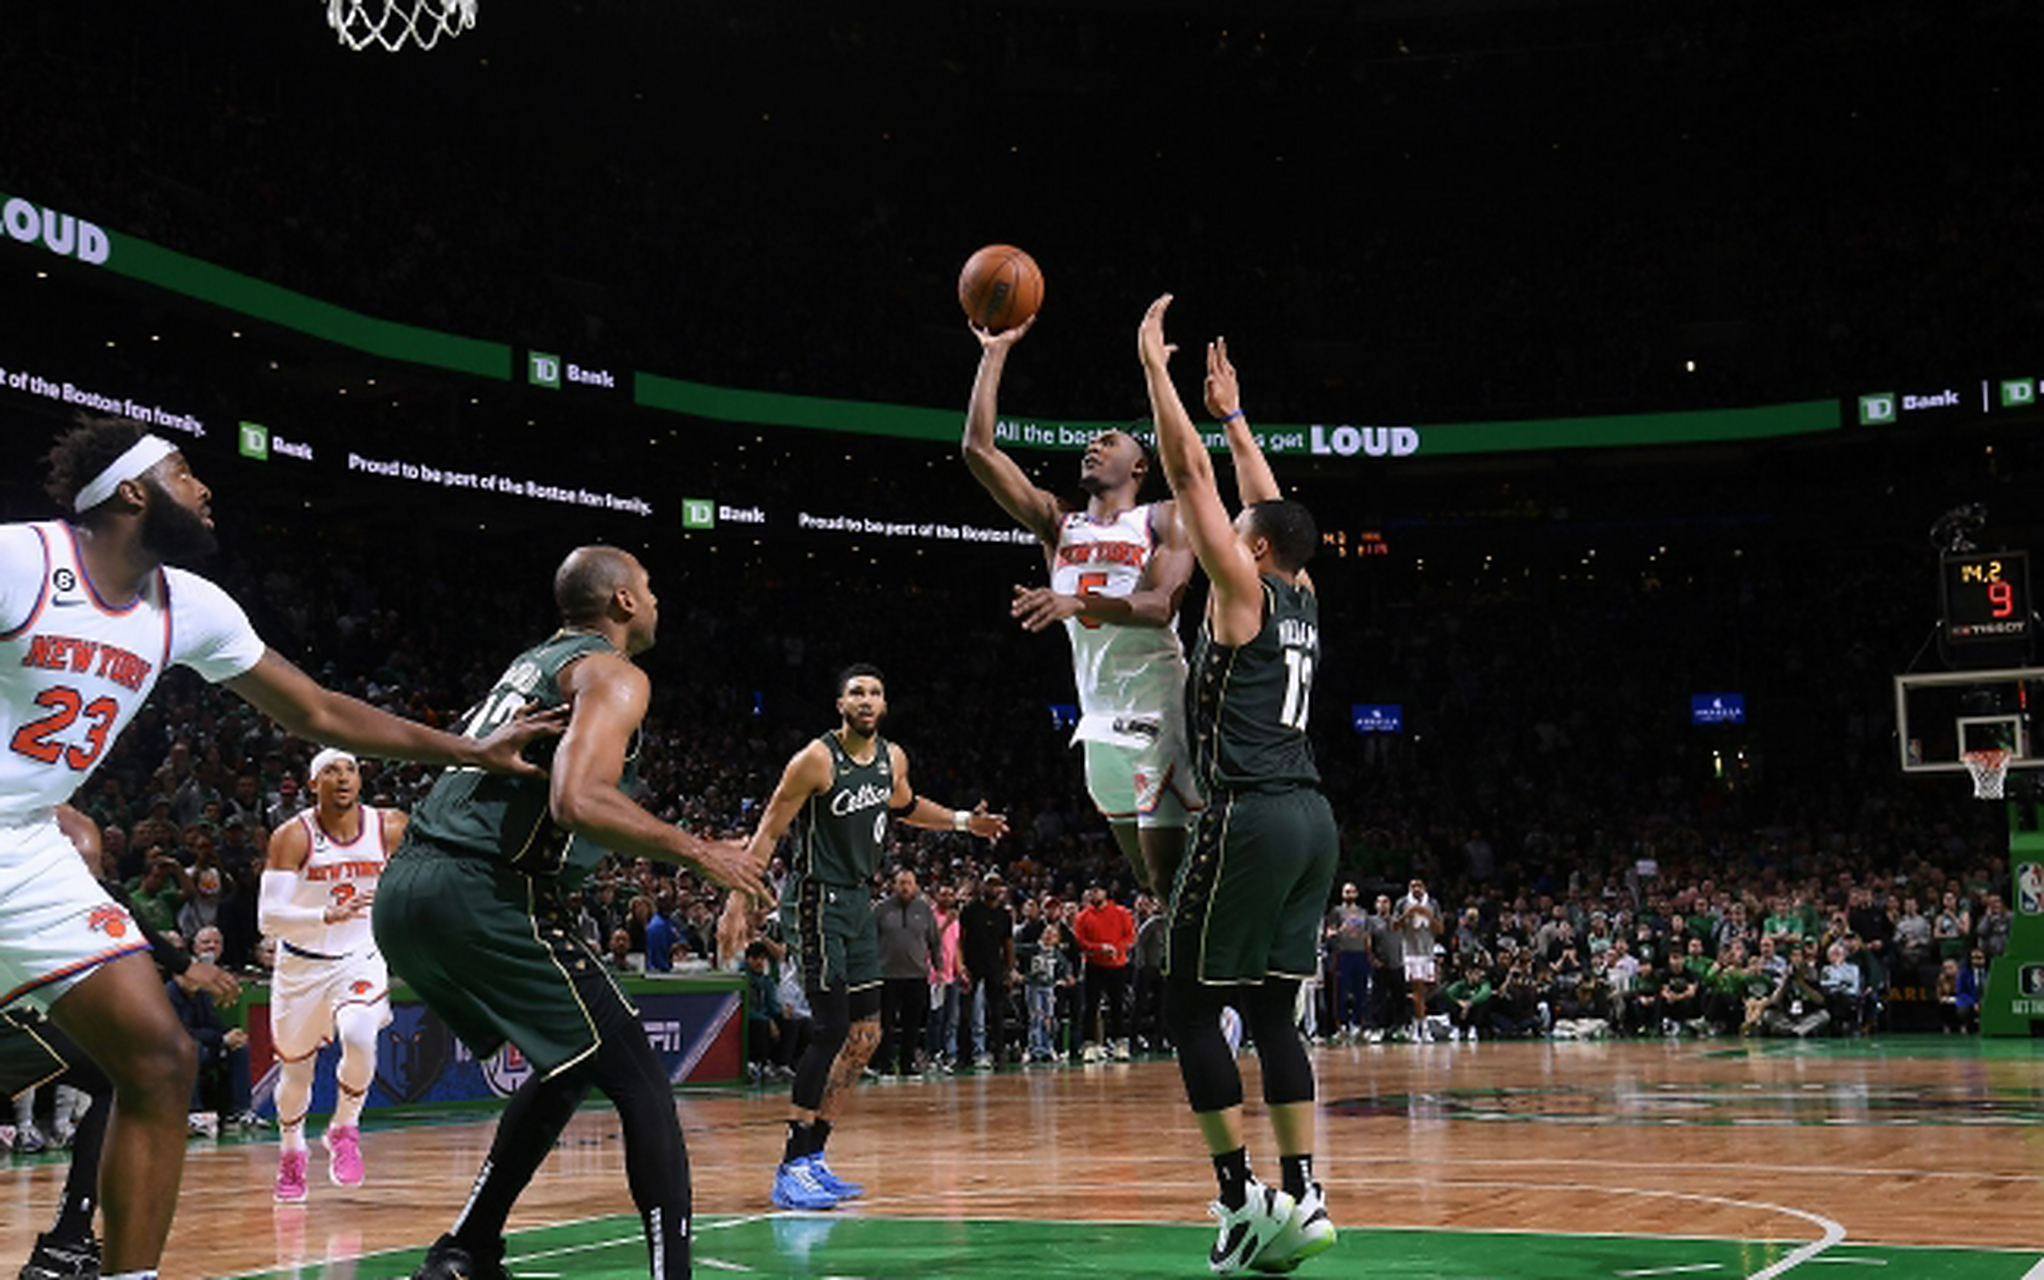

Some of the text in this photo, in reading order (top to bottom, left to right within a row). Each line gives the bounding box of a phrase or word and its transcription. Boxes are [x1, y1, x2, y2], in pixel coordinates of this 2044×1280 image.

[0, 198, 110, 265] OUD
[567, 364, 614, 388] Bank
[9, 372, 28, 390] of
[31, 376, 60, 400] the
[63, 383, 122, 415] Boston
[125, 400, 152, 422] fan
[1903, 389, 1960, 410] Bank
[272, 435, 314, 461] Bank
[995, 421, 1020, 441] All
[1023, 424, 1054, 444] the
[1270, 433, 1303, 452] get
[1310, 425, 1420, 456] LOUD
[349, 453, 399, 476] Proud
[401, 463, 418, 480] to
[421, 464, 441, 482] be
[443, 470, 478, 488] part
[480, 475, 497, 491] of
[499, 478, 523, 495] the
[526, 481, 575, 503] Boston
[578, 488, 603, 507] fan
[719, 506, 765, 523] Bank
[799, 512, 844, 531] Proud
[846, 518, 862, 532] to
[864, 518, 884, 533] be
[886, 522, 917, 536] part
[919, 523, 935, 536] of
[936, 524, 959, 539] the
[962, 525, 1009, 542] Boston
[1988, 581, 2013, 617] 9
[1971, 621, 2025, 635] TISSOT
[22, 635, 151, 692] NEW YORK
[9, 685, 119, 771] 23
[873, 811, 887, 844] 0
